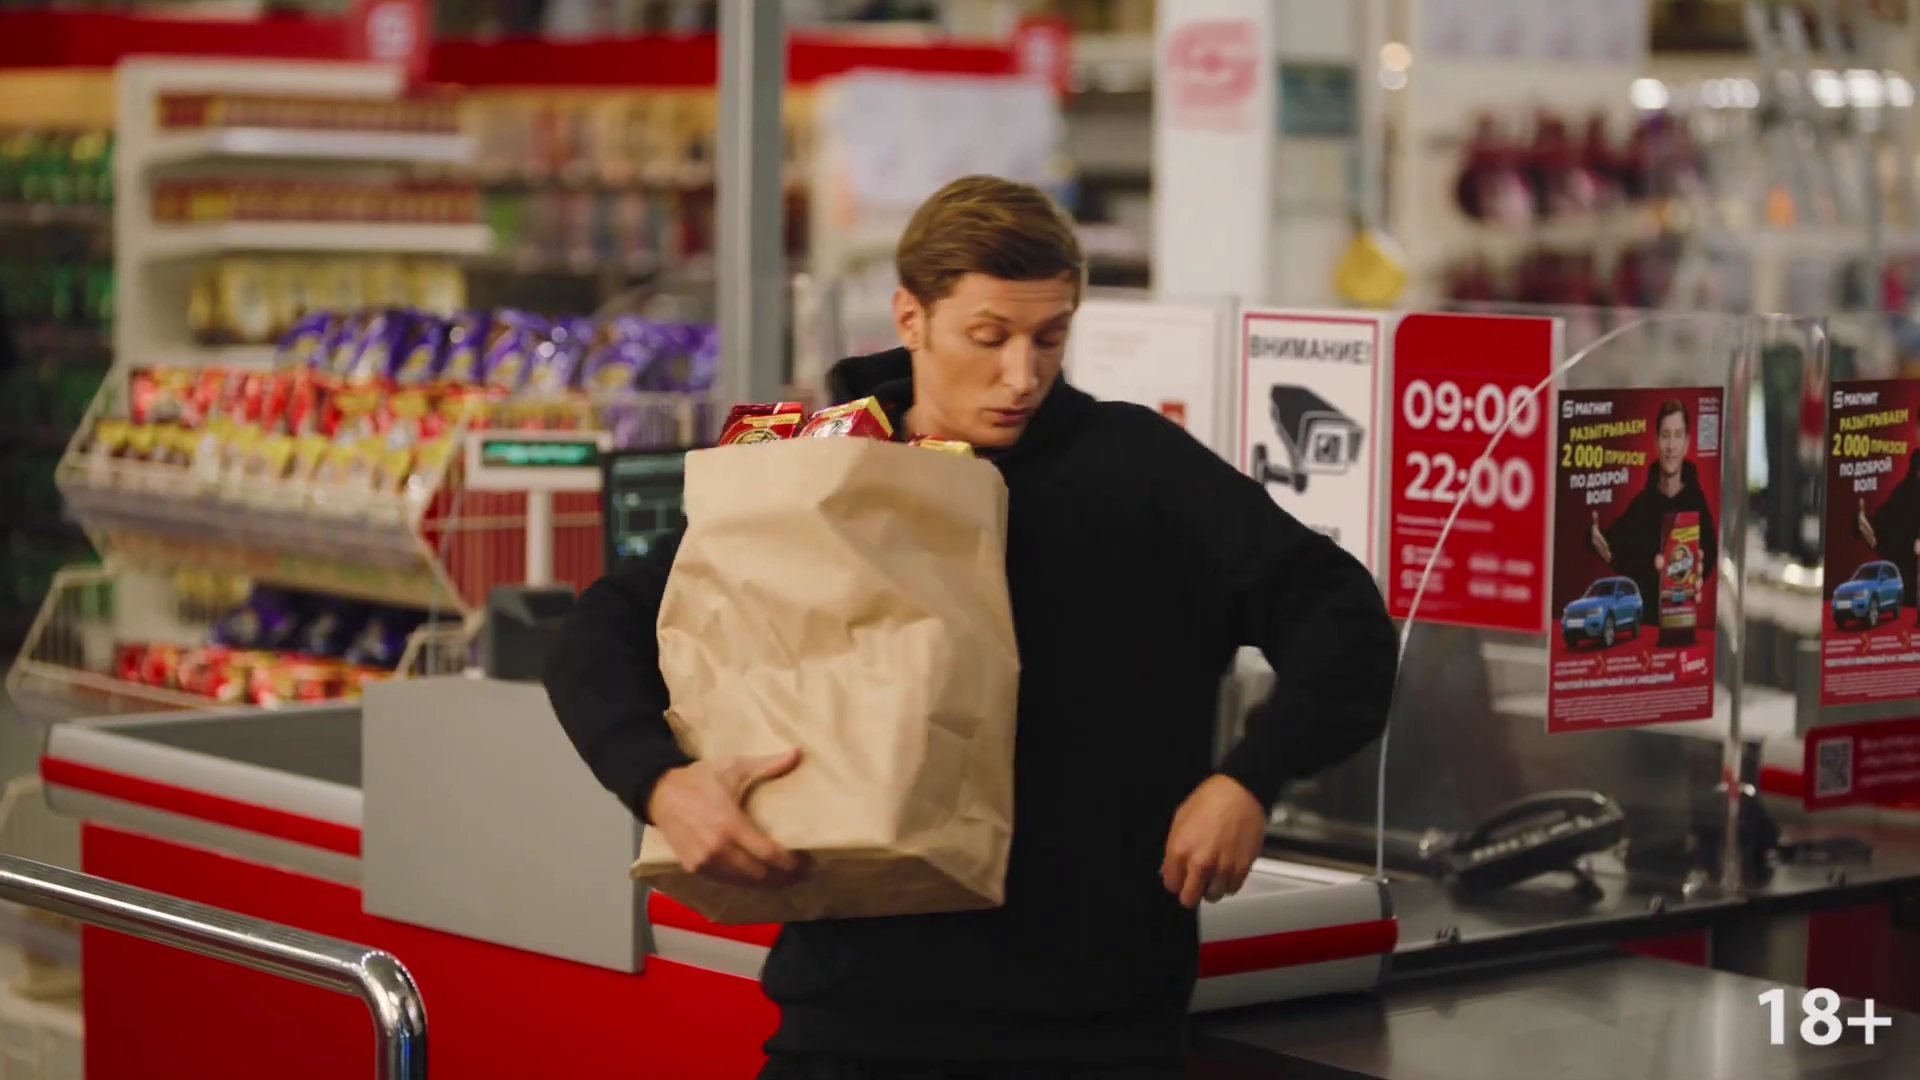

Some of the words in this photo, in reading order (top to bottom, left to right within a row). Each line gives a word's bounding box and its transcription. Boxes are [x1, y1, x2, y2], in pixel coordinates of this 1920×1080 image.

[1250, 334, 1371, 365] ВНИМАНИЕ!
[1403, 379, 1540, 438] 09:00
[1574, 402, 1613, 415] МАГНИТ
[1844, 392, 1879, 406] МАГНИТ
[1569, 419, 1647, 441] РАЗЫГРЫВАЕМ
[1839, 409, 1909, 431] РАЗЫГРЫВАЕМ
[1604, 452, 1646, 466] ПРИЗОВ
[1839, 463, 1852, 477] ПО
[1853, 456, 1893, 477] ДОБРОЙ
[1404, 450, 1534, 511] 22:00
[1570, 474, 1585, 489] ПО
[1586, 467, 1629, 488] ДОБРОЙ
[1853, 478, 1878, 492] ВОЛЕ
[1586, 489, 1613, 505] ВОЛЕ
